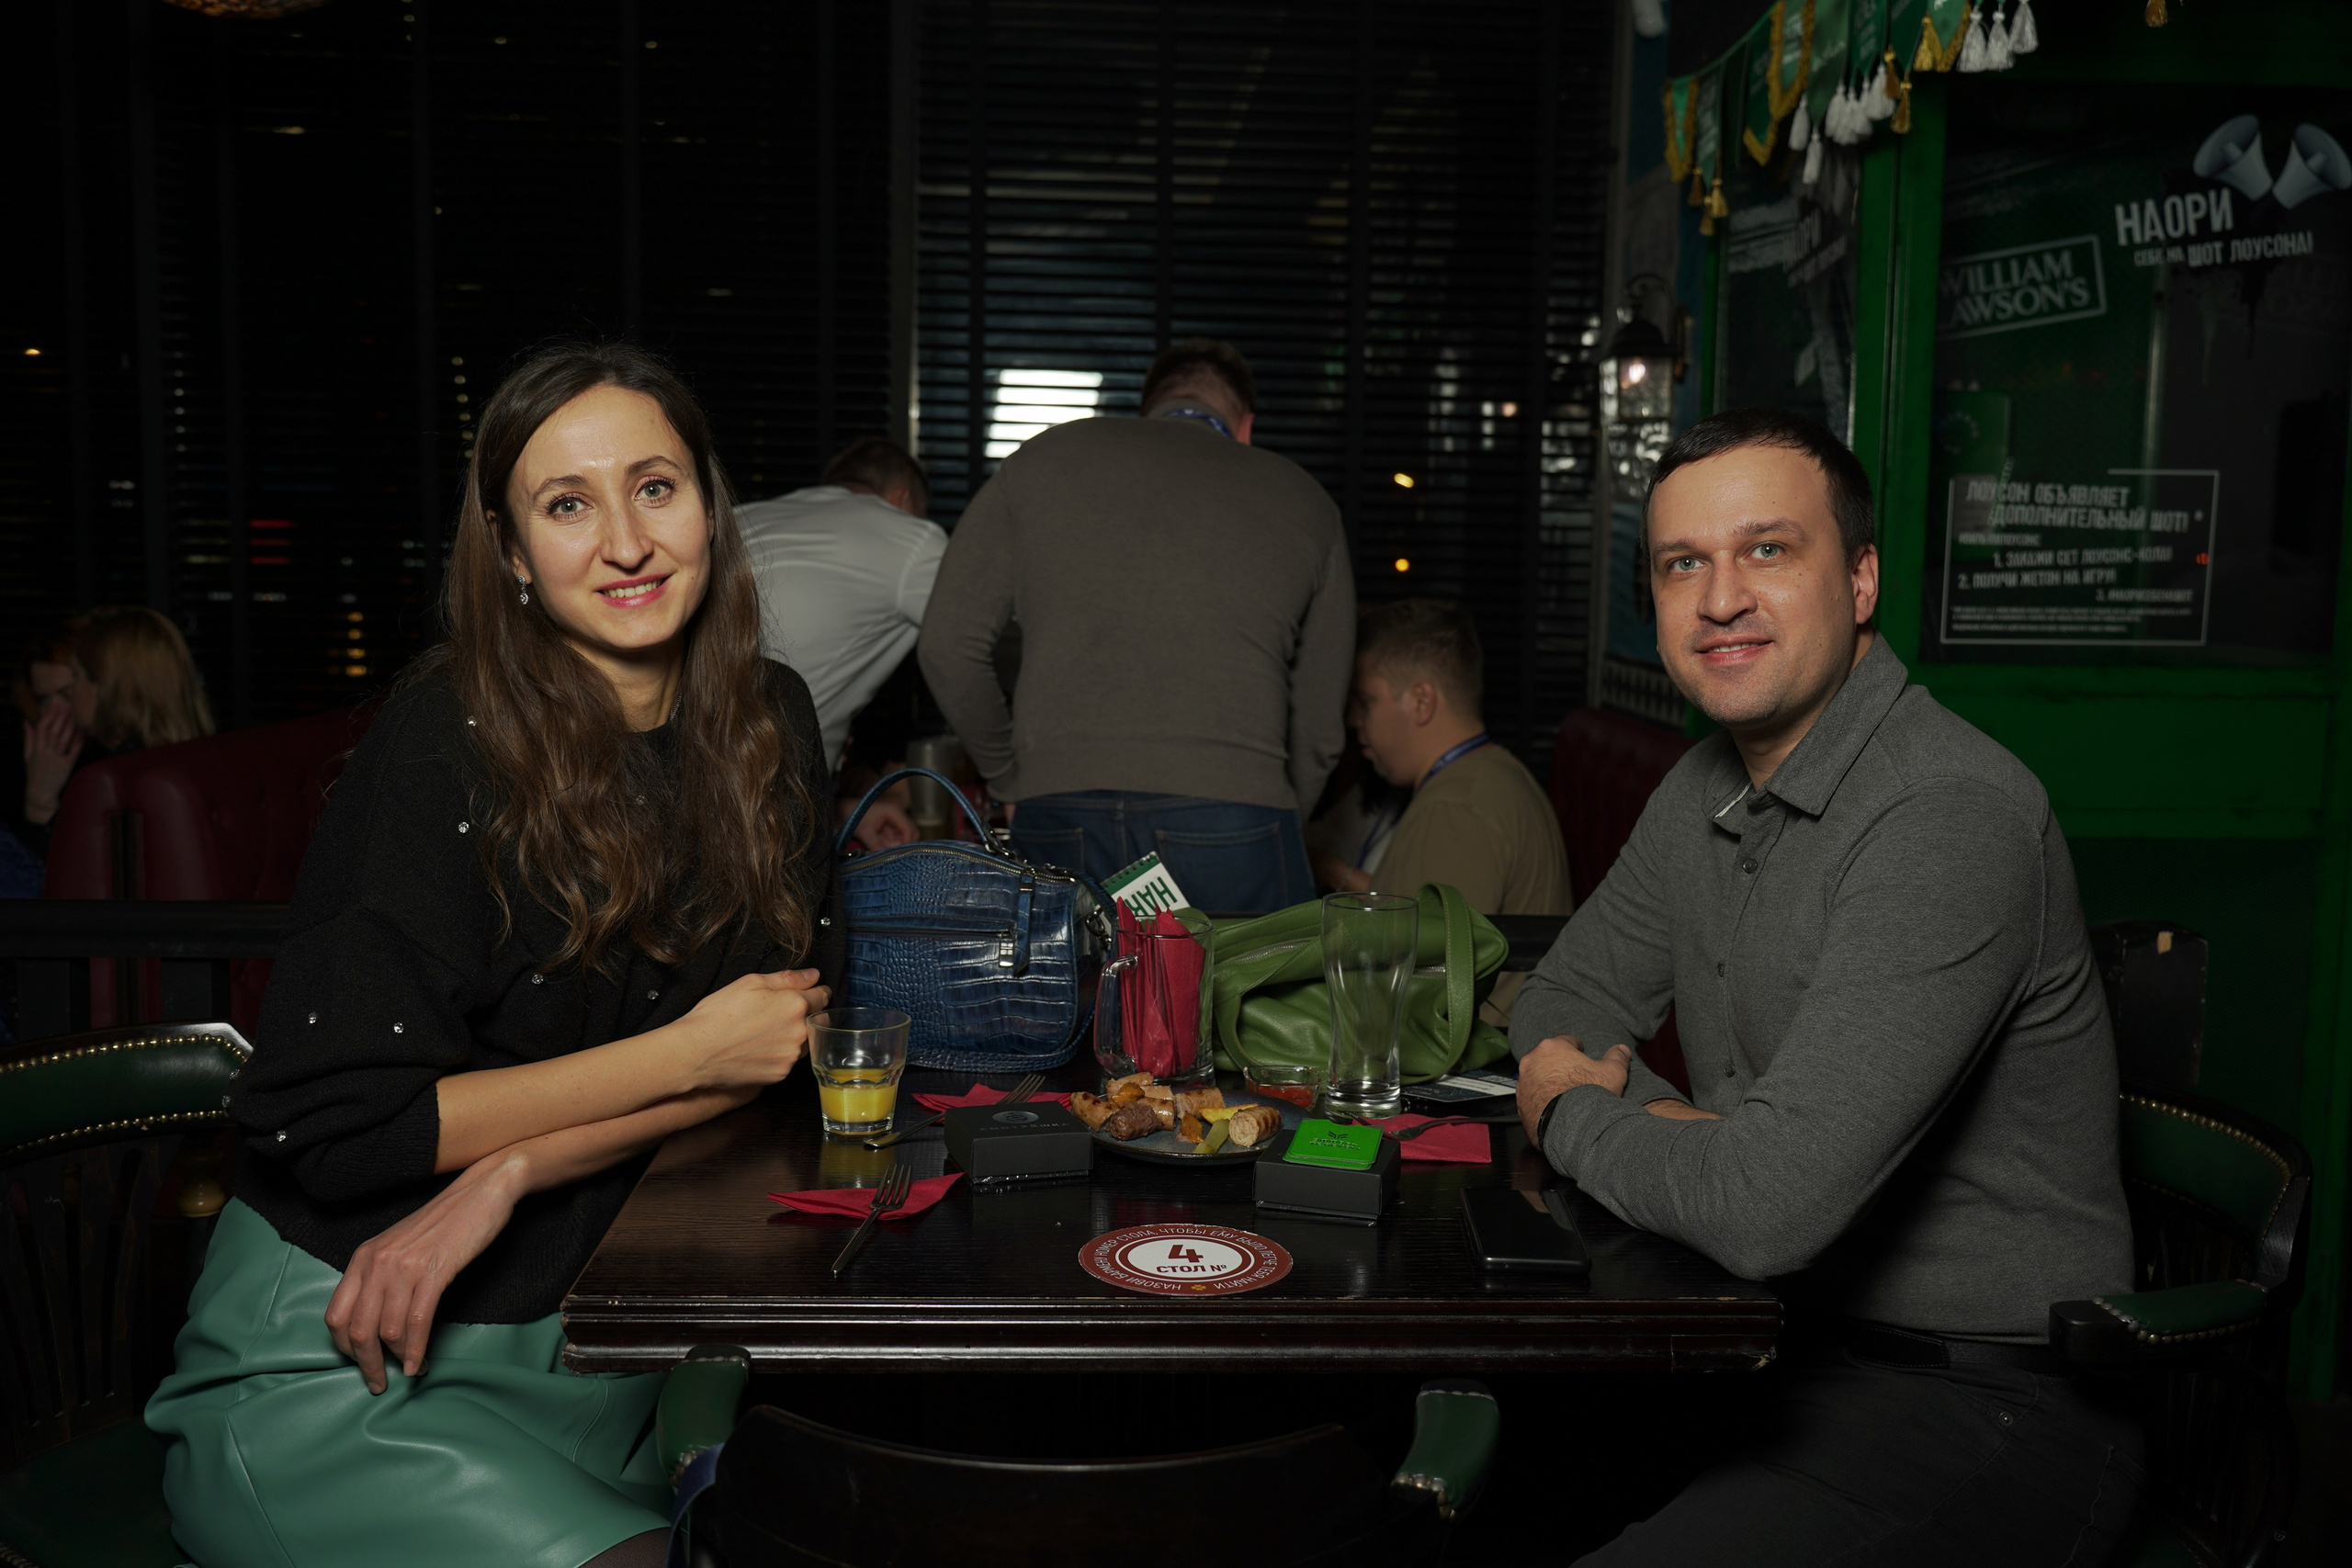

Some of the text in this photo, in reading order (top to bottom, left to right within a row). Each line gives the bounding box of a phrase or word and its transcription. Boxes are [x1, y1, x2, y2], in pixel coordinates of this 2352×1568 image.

[2115, 187, 2234, 246] НАОРИ
[2188, 241, 2224, 267] ШОТ
[2229, 230, 2314, 264] ЛОУСОНА!
[1966, 479, 2132, 508] ЛОУСОН ОБЪЯВЛЯЕТ
[1989, 503, 2189, 533] ДОПОЛНИТЕЛЬНЫЙ ШОТ!
[2005, 550, 2055, 568] ЗАКАЖИ
[1958, 572, 1972, 590] 2.
[2019, 570, 2062, 588] ЖЕТОН
[2063, 569, 2081, 586] НА
[1116, 1229, 1159, 1242] СТОЛА,
[1210, 1230, 1238, 1239] ЕМУ
[1236, 1236, 1268, 1250] БЫЛО
[1093, 1239, 1118, 1257] НОМЕР
[1169, 1245, 1204, 1263] 4
[1259, 1250, 1277, 1266] ЛЕГЧЕ
[1093, 1256, 1129, 1280] БАРМЕНУ
[1156, 1265, 1206, 1273] СТОЛ
[1253, 1266, 1276, 1279] ТЕБЯ
[1125, 1276, 1182, 1291] НАЗОВИ
[1213, 1274, 1257, 1290] НАЙТИ
